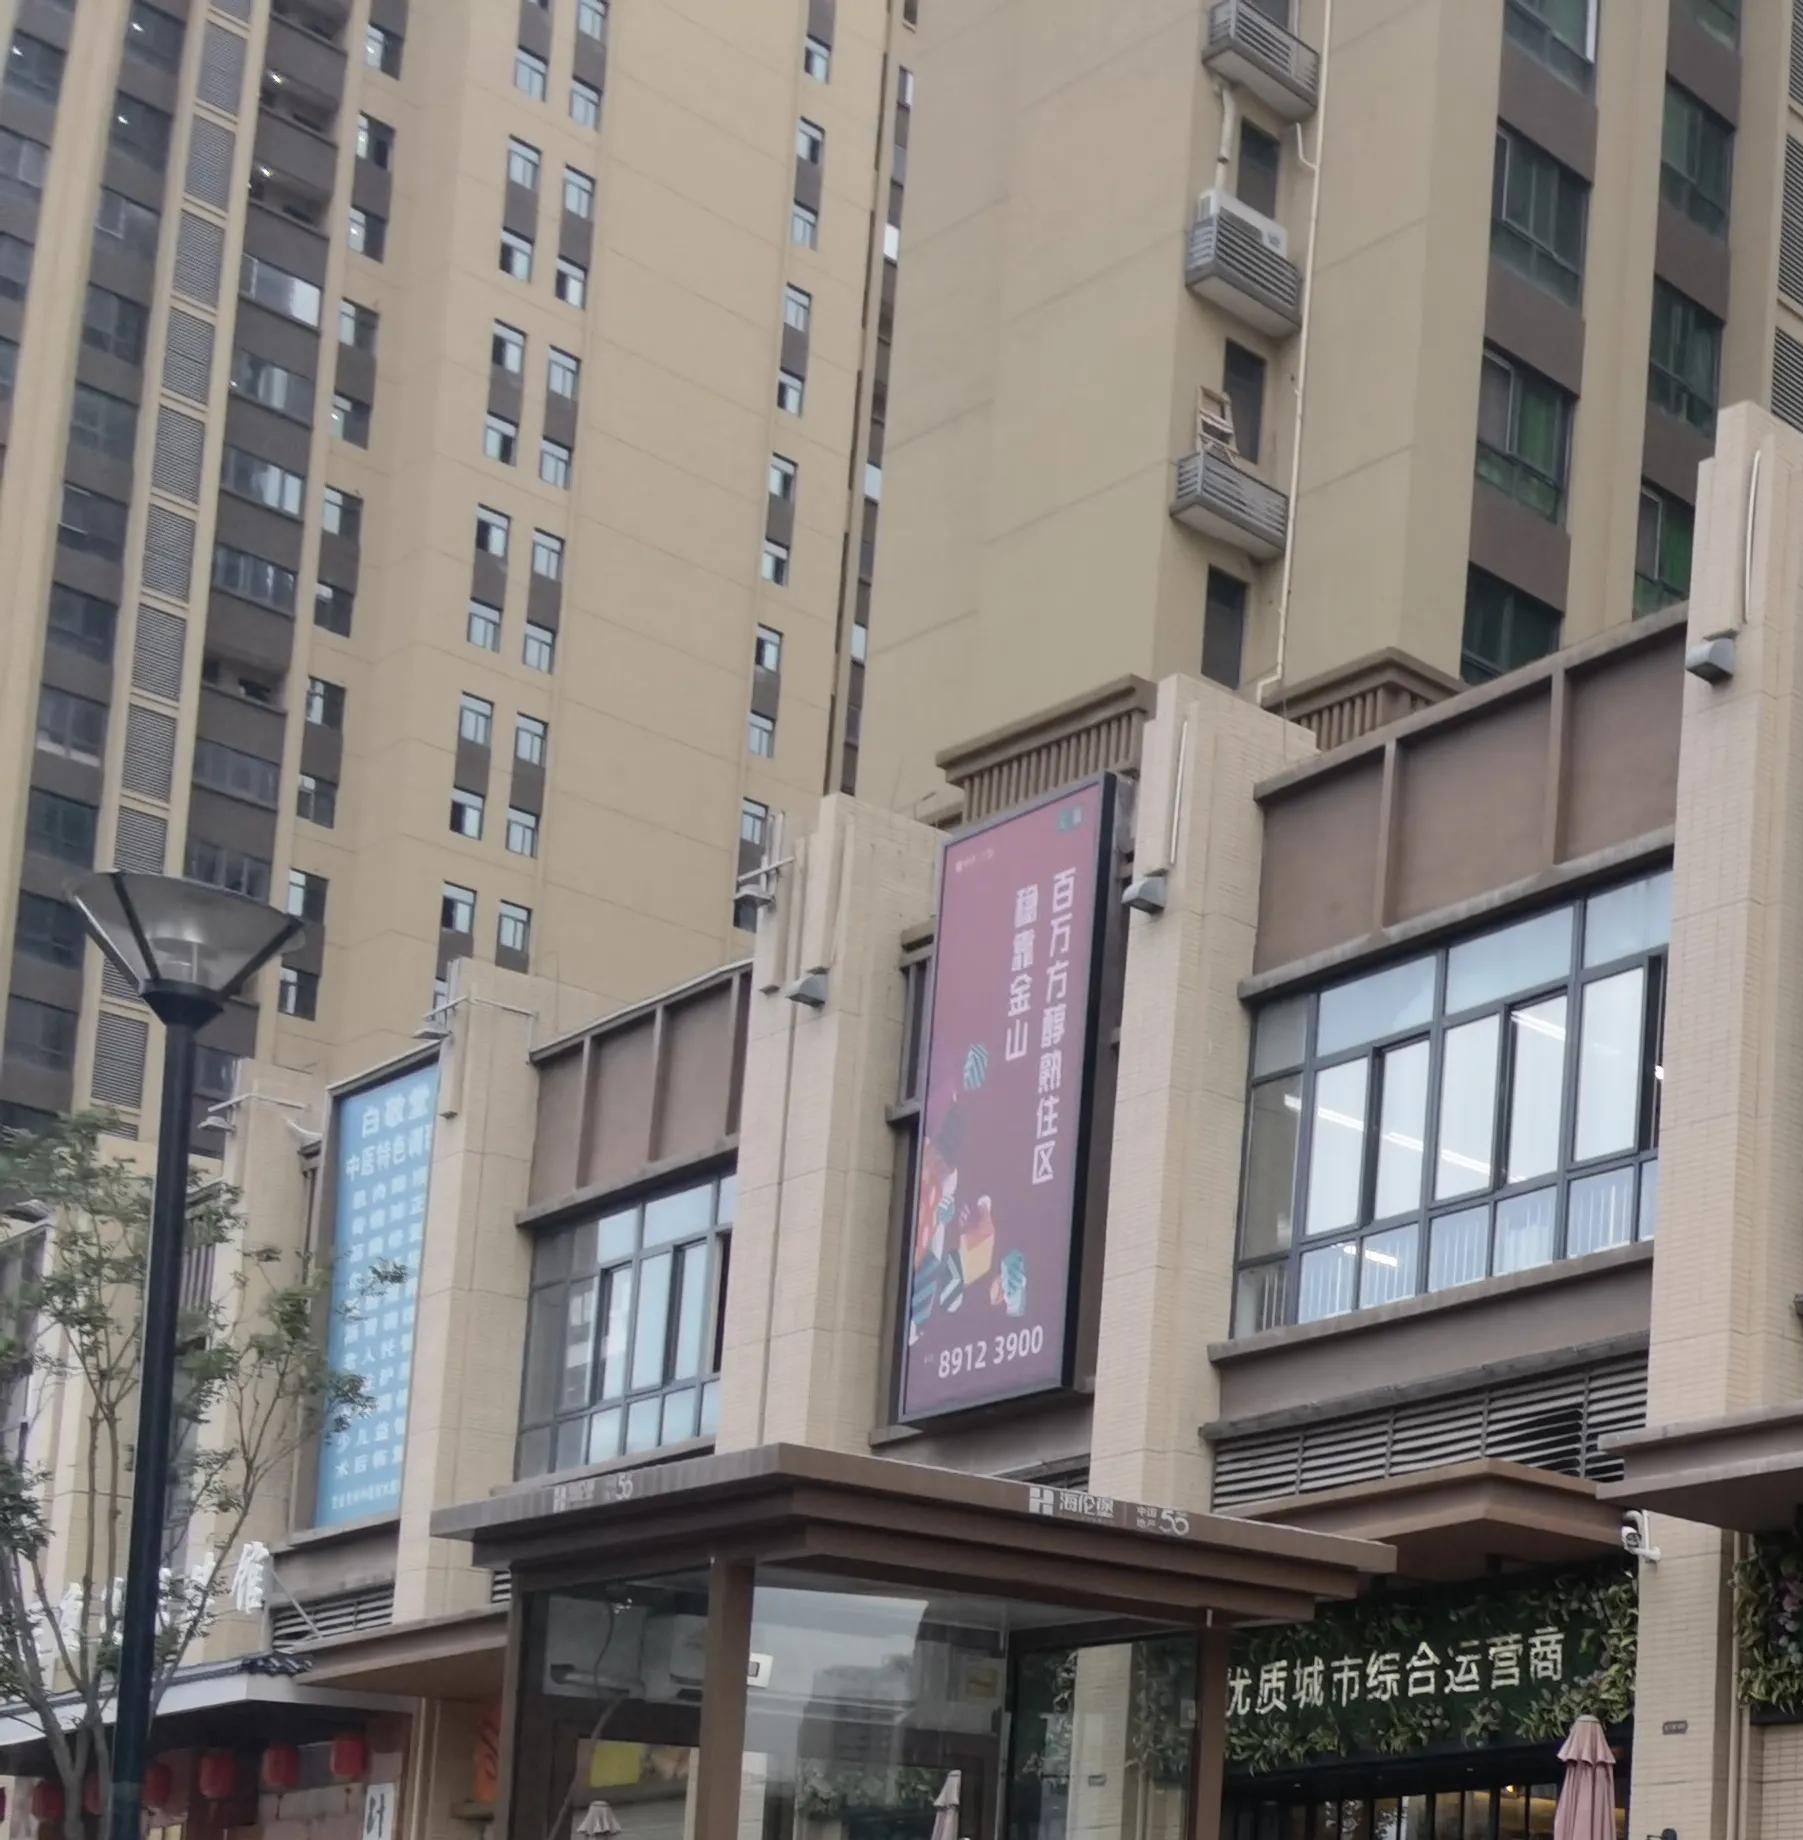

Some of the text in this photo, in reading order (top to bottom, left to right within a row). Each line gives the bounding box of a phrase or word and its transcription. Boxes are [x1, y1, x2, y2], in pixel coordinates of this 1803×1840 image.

[938, 1324, 1043, 1378] 8912 3900
[1226, 1627, 1565, 1718] 优质城市综合运营商
